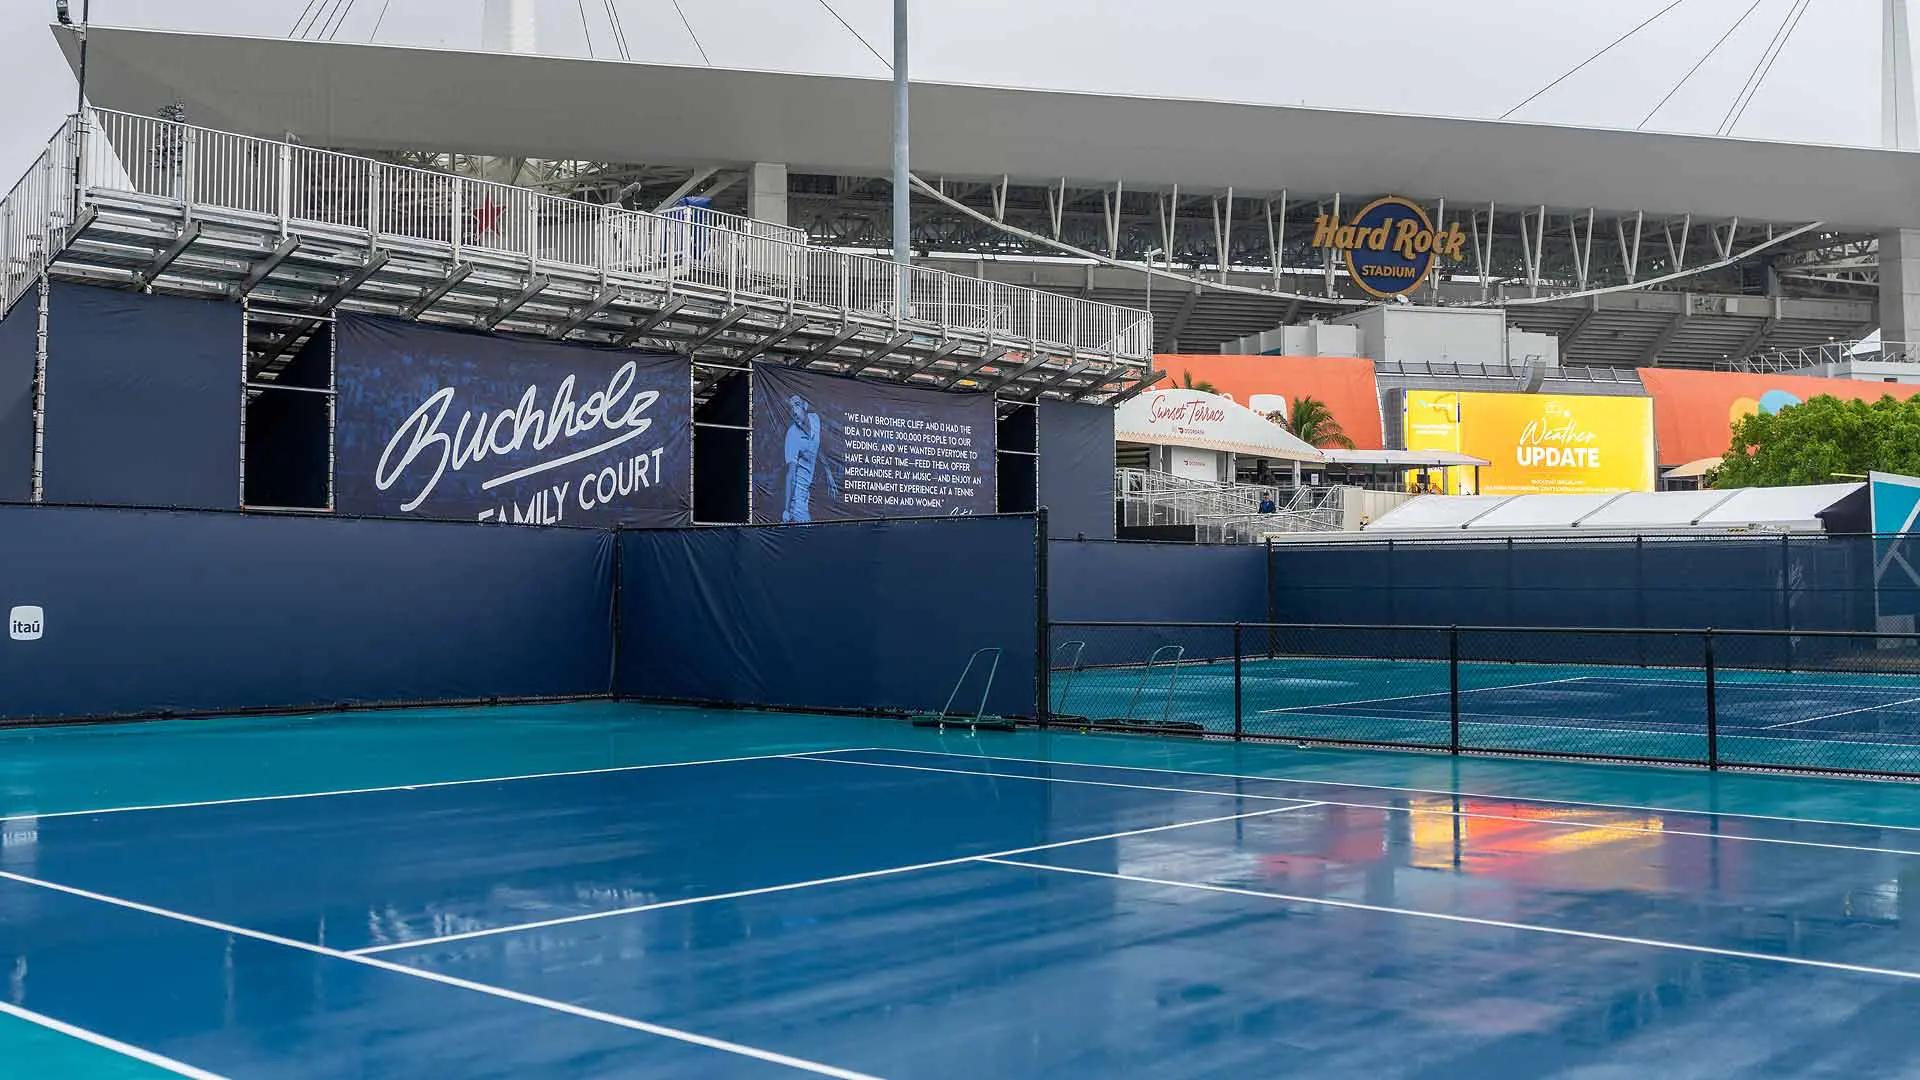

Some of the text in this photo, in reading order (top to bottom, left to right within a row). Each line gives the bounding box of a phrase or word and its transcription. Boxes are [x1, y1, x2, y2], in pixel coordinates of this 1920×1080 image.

[1312, 214, 1466, 262] Hard Rock
[1362, 265, 1416, 277] STADIUM
[1148, 394, 1225, 425] Sunset Terrace
[875, 417, 905, 426] BROTHER
[907, 420, 924, 429] CLIFF
[926, 422, 939, 430] AND
[946, 424, 958, 433] HAD
[960, 426, 971, 434] THE
[1520, 417, 1597, 446] Weather
[375, 360, 660, 512] Buchholz
[845, 426, 860, 436] IDEA
[863, 428, 871, 437] TO
[874, 429, 893, 439] INVITE
[923, 434, 947, 444] PEOPLE
[948, 436, 956, 445] TO
[959, 437, 971, 446] OUR
[881, 444, 895, 452] AND
[897, 445, 907, 453] WE
[910, 446, 935, 456] WANTED
[937, 448, 968, 459] EVERYONE
[969, 451, 977, 459] TO
[1516, 447, 1600, 468] UPDATE
[845, 454, 862, 463] HAVE
[872, 456, 892, 465] GREAT
[952, 463, 970, 471] OFFER
[478, 447, 665, 525] AMILY COURT
[895, 470, 910, 480] PLAY
[952, 475, 971, 484] ENJOY
[845, 480, 897, 492] ENTERTAINMENT
[900, 484, 937, 495] EXPERIENCE
[939, 487, 947, 495] AT
[955, 488, 974, 497] TENNIS
[845, 494, 866, 504] EVENT
[869, 496, 882, 504] FOR
[885, 497, 898, 505] MEN
[900, 498, 913, 506] AND
